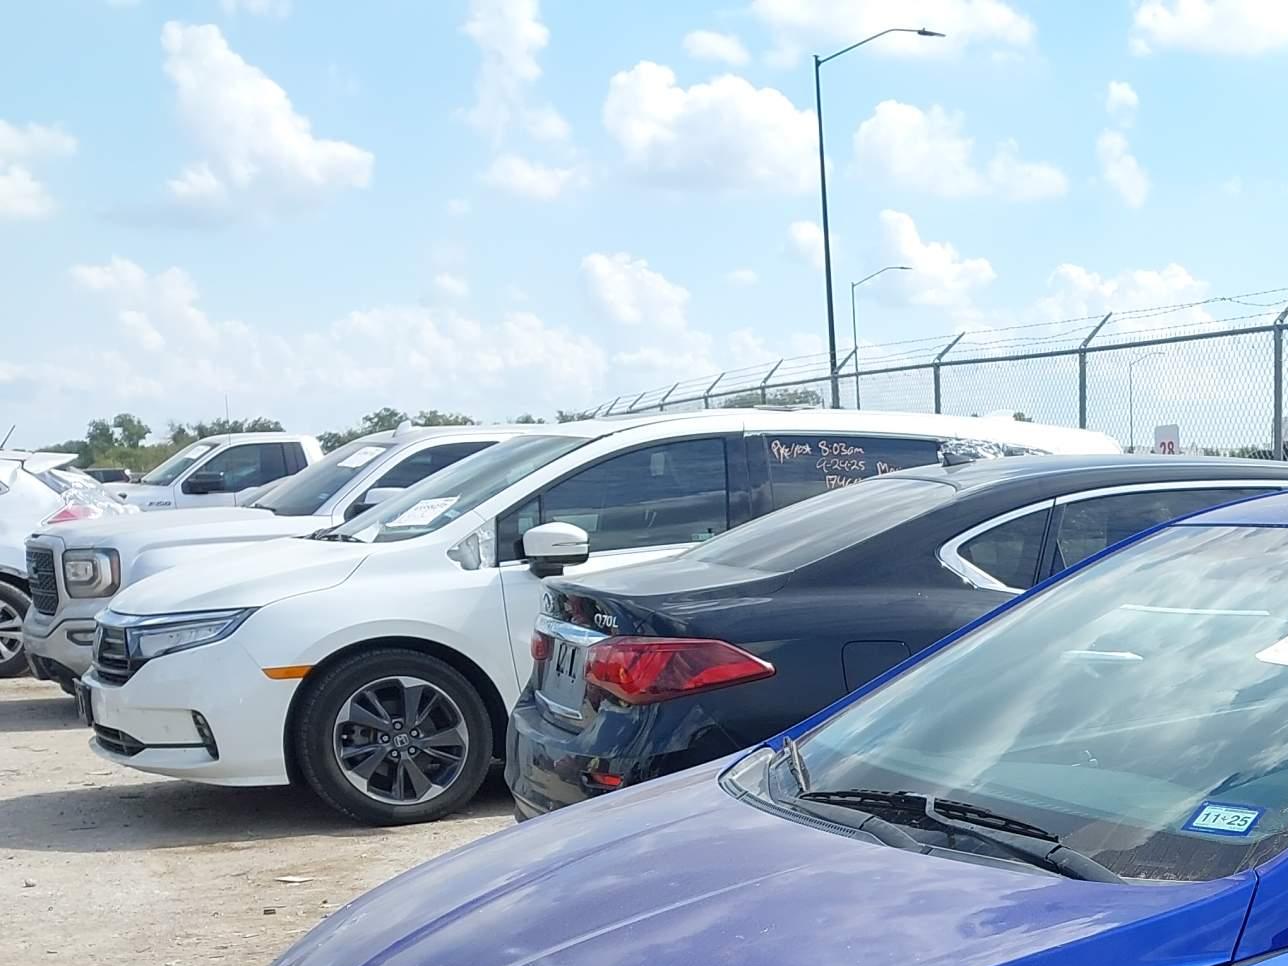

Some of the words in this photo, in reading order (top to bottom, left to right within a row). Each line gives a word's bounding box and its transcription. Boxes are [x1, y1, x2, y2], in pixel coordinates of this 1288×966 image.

[818, 440, 865, 456] 8:03am
[1159, 440, 1176, 455] 28
[594, 613, 619, 629] Q70L
